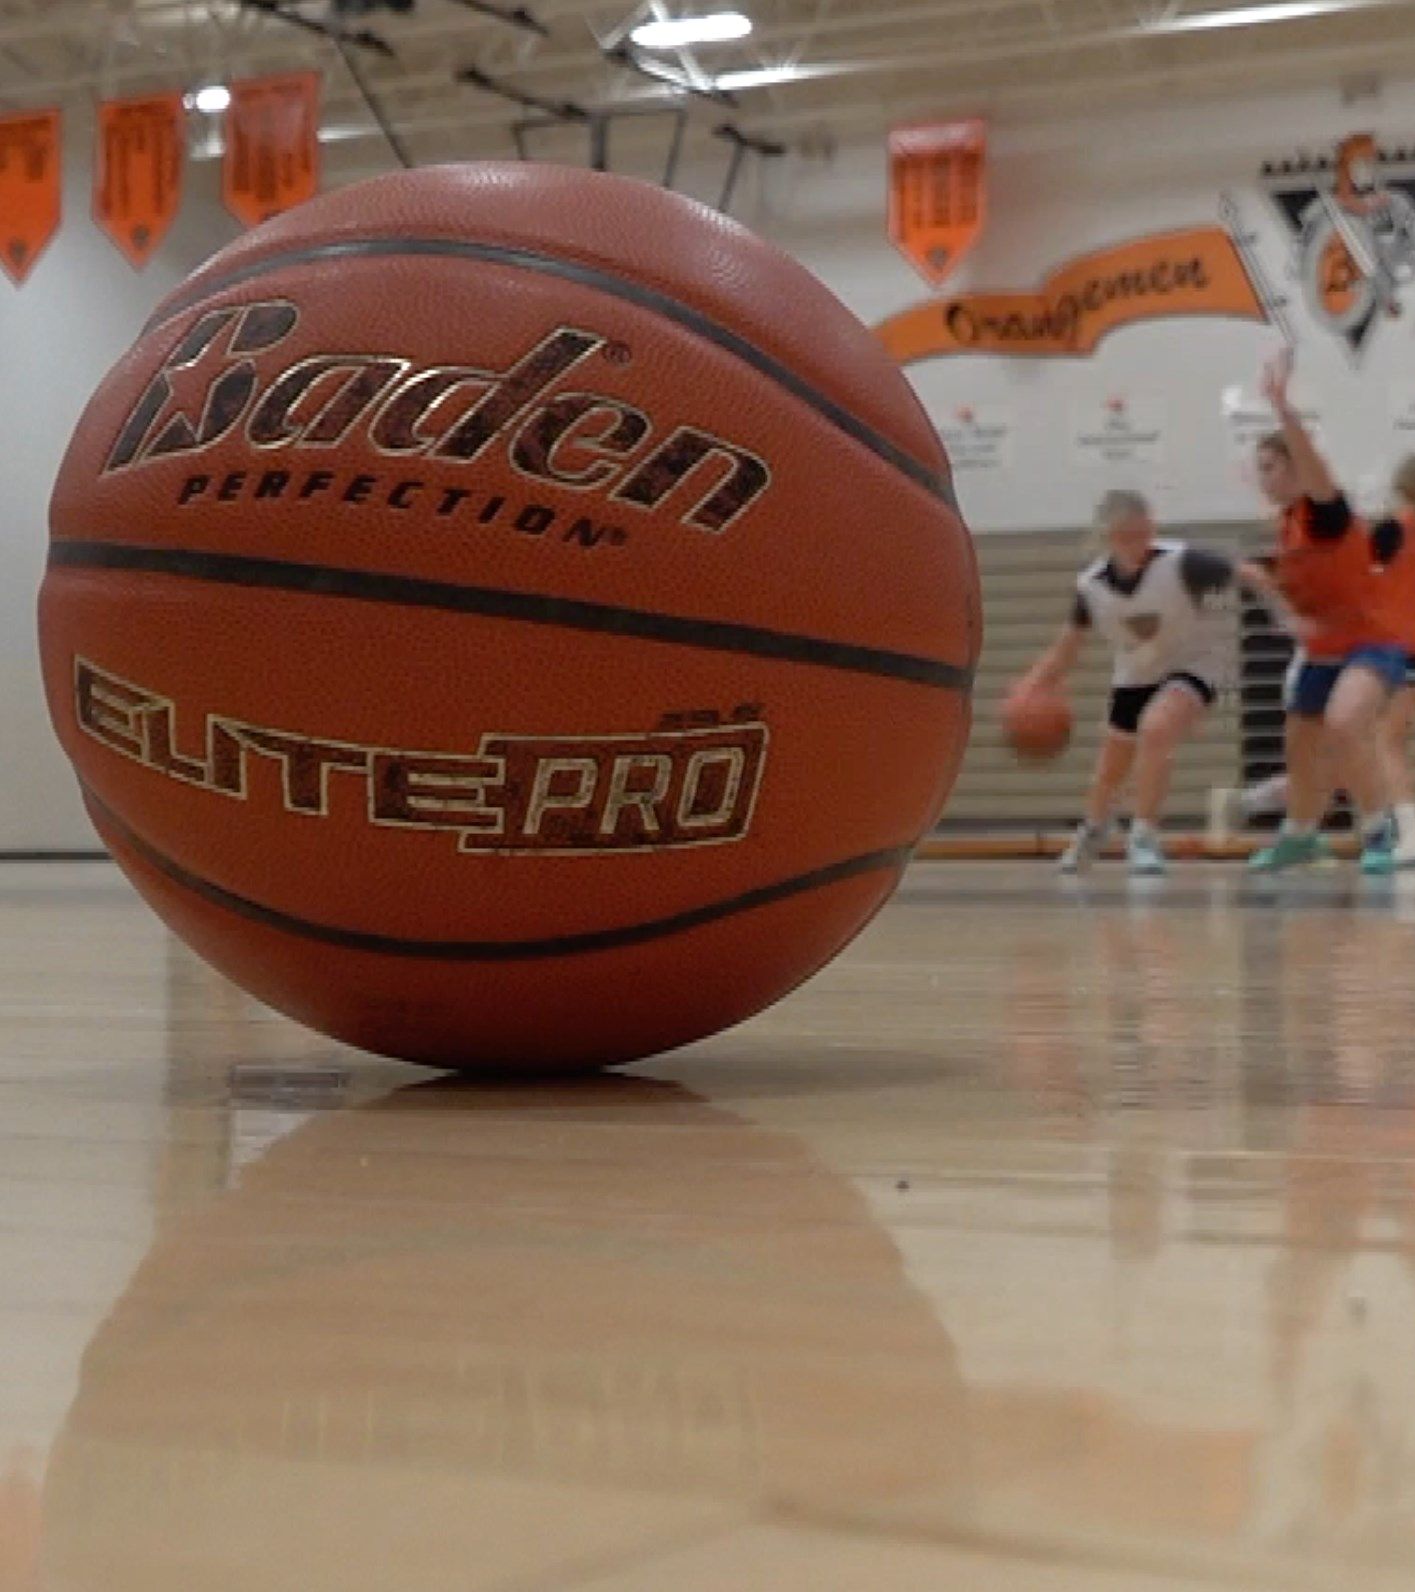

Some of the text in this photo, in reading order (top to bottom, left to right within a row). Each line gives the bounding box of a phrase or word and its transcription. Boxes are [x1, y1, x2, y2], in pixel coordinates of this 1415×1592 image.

[945, 256, 1210, 351] Orangemen
[102, 298, 772, 533] Baden
[178, 470, 602, 548] PERFECTION
[75, 655, 744, 836] ELITE PRO
